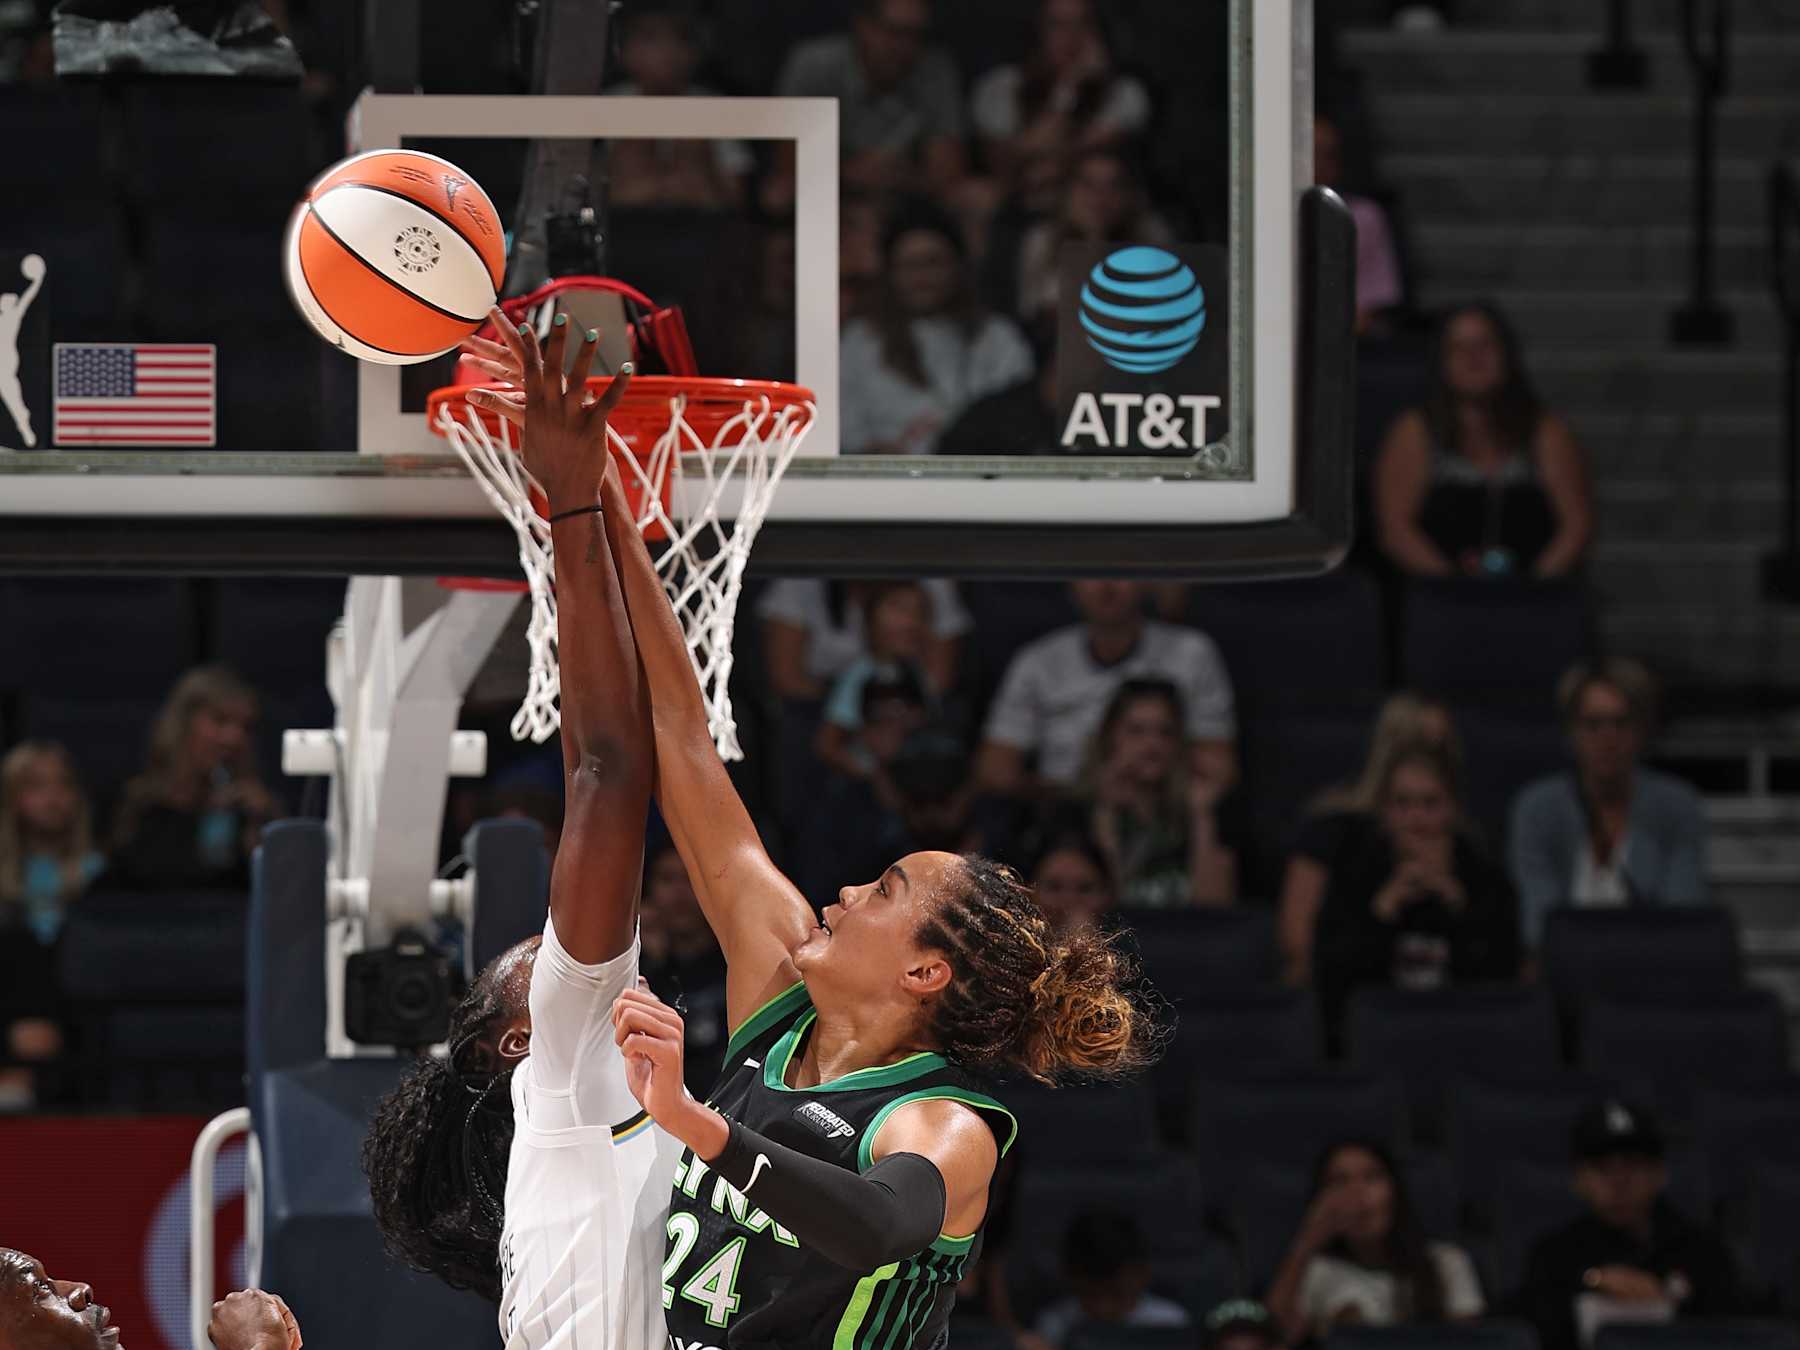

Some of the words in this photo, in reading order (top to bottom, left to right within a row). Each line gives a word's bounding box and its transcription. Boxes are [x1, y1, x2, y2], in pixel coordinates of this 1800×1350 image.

[1061, 392, 1221, 449] AT&T
[803, 1101, 856, 1137] FEDERATED
[661, 1211, 747, 1329] 24
